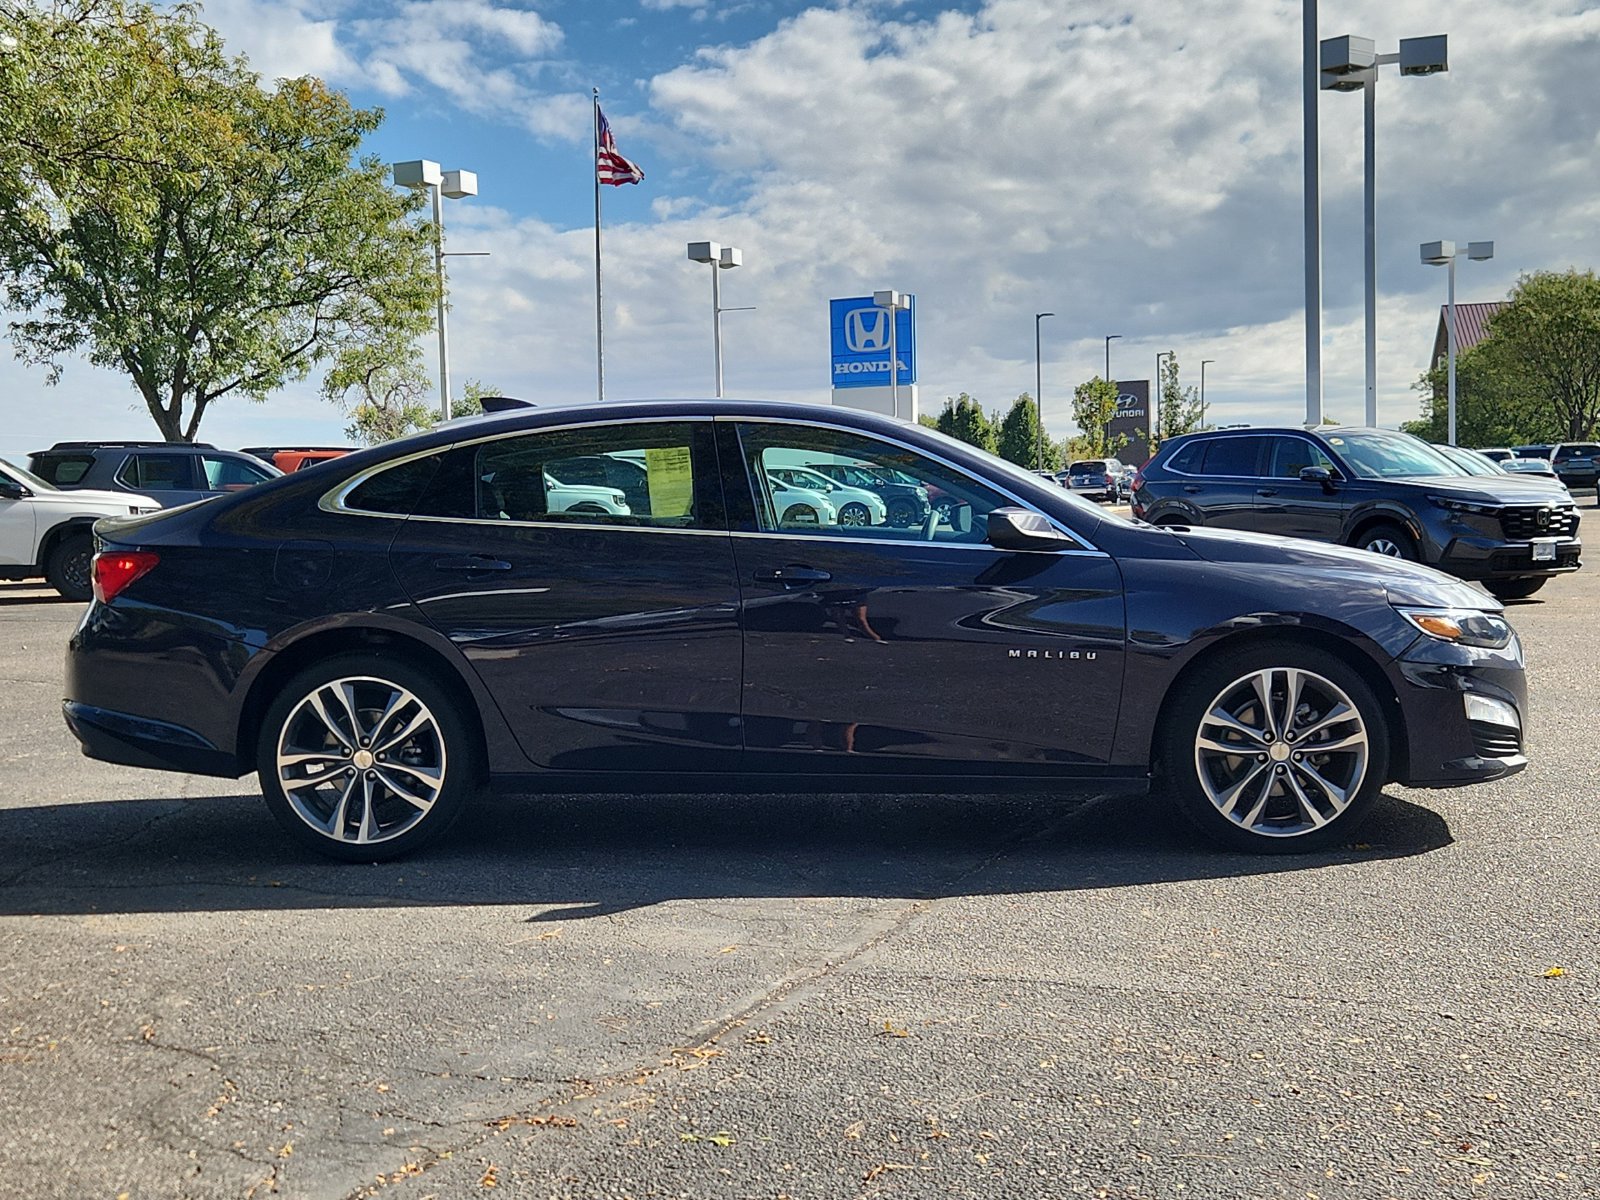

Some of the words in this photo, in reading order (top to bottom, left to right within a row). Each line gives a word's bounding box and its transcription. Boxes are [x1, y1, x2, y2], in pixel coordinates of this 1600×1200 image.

[834, 359, 908, 374] HONDA
[1108, 409, 1144, 418] YUNDAI
[1008, 649, 1097, 660] MALIBU
